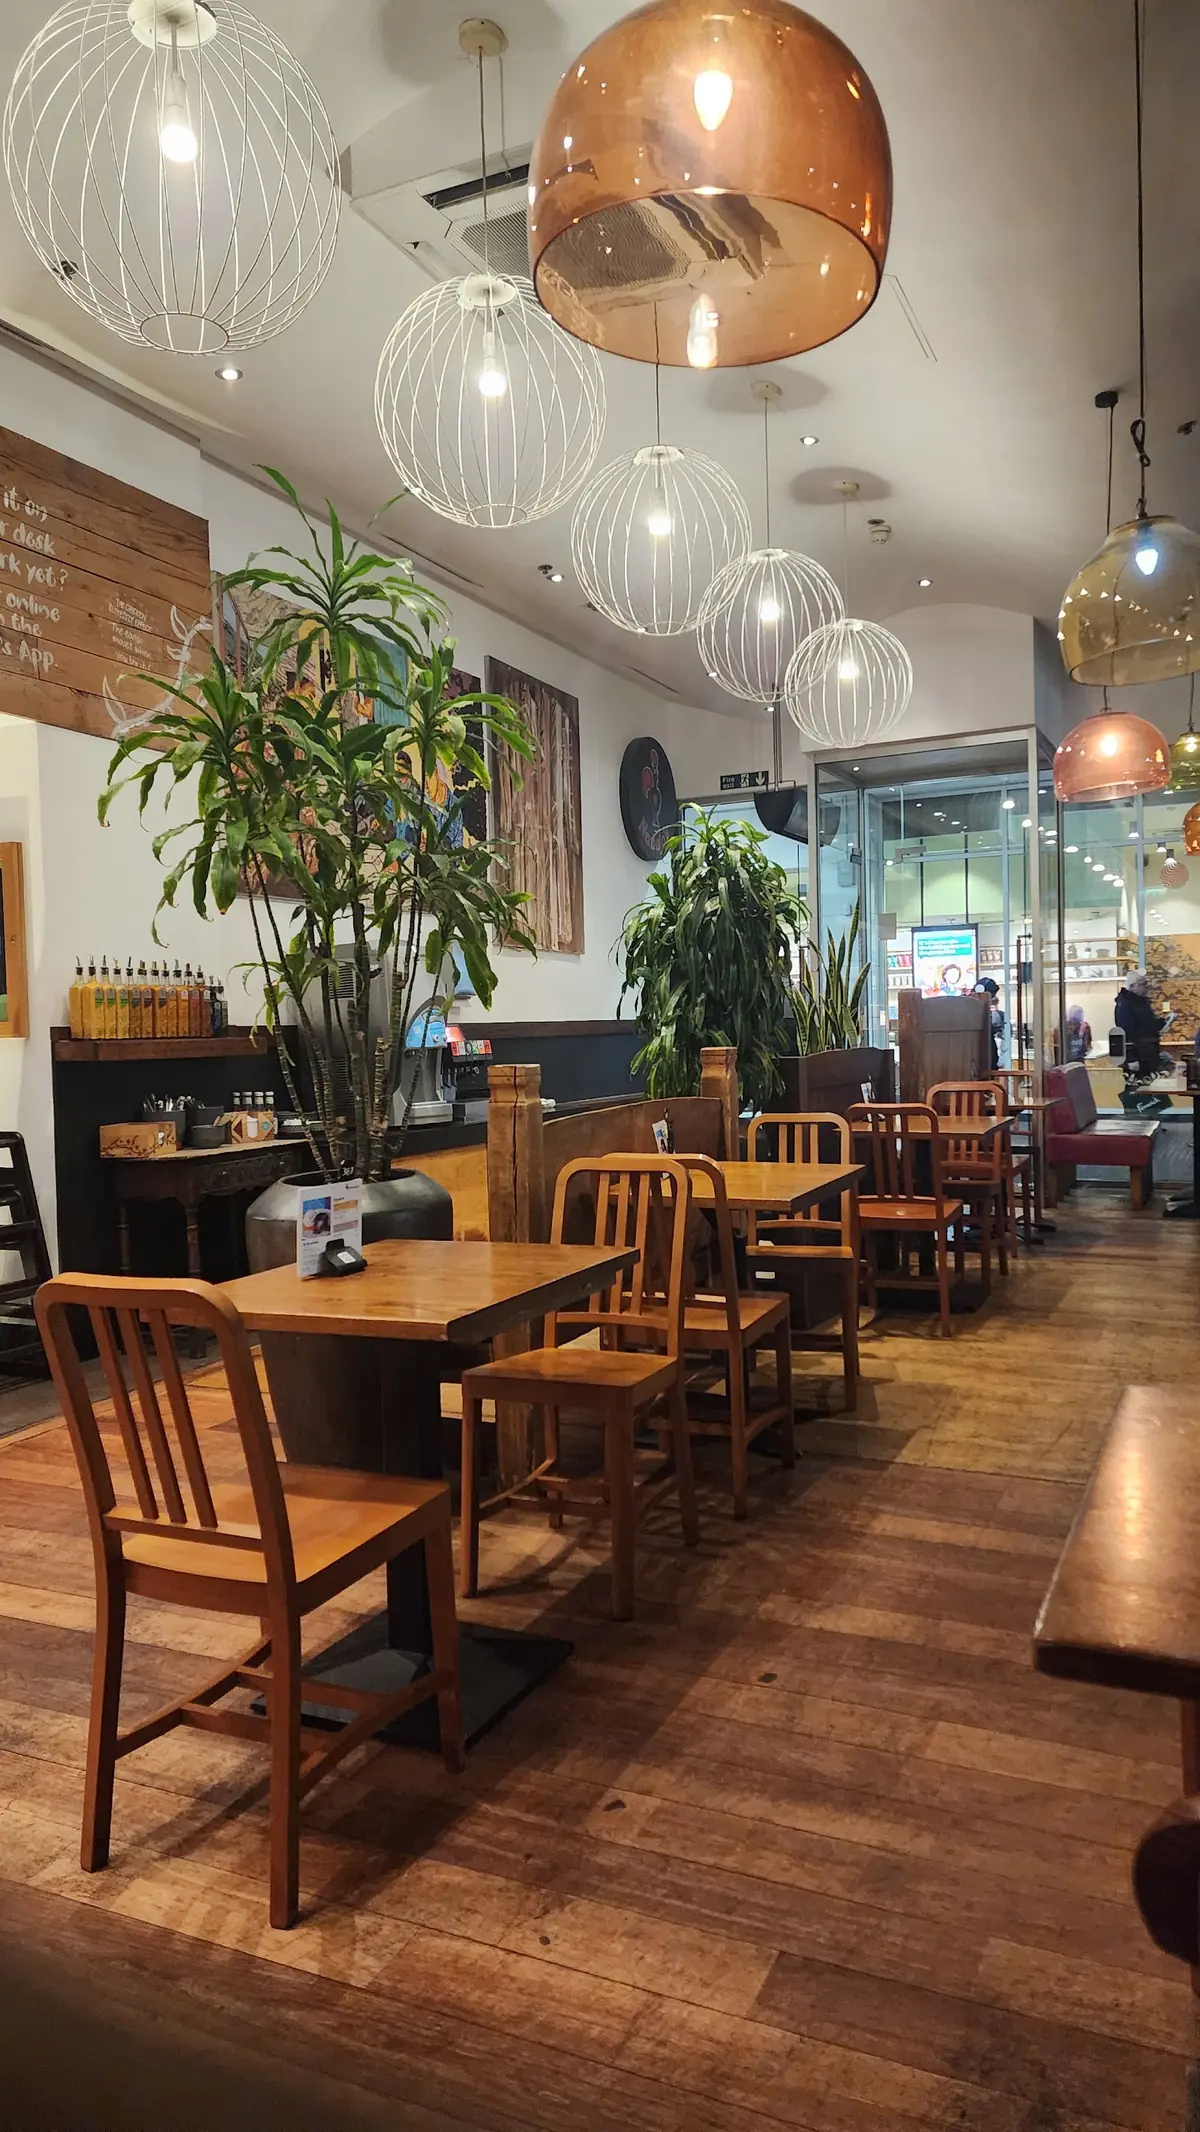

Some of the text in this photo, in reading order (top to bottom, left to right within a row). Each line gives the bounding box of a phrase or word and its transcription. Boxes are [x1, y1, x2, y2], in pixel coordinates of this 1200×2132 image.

[3, 485, 20, 512] it
[12, 522, 56, 556] desk
[25, 563, 68, 592] yet?
[5, 593, 60, 623] online
[11, 612, 42, 637] the
[19, 640, 58, 674] App.
[722, 776, 735, 784] Fire
